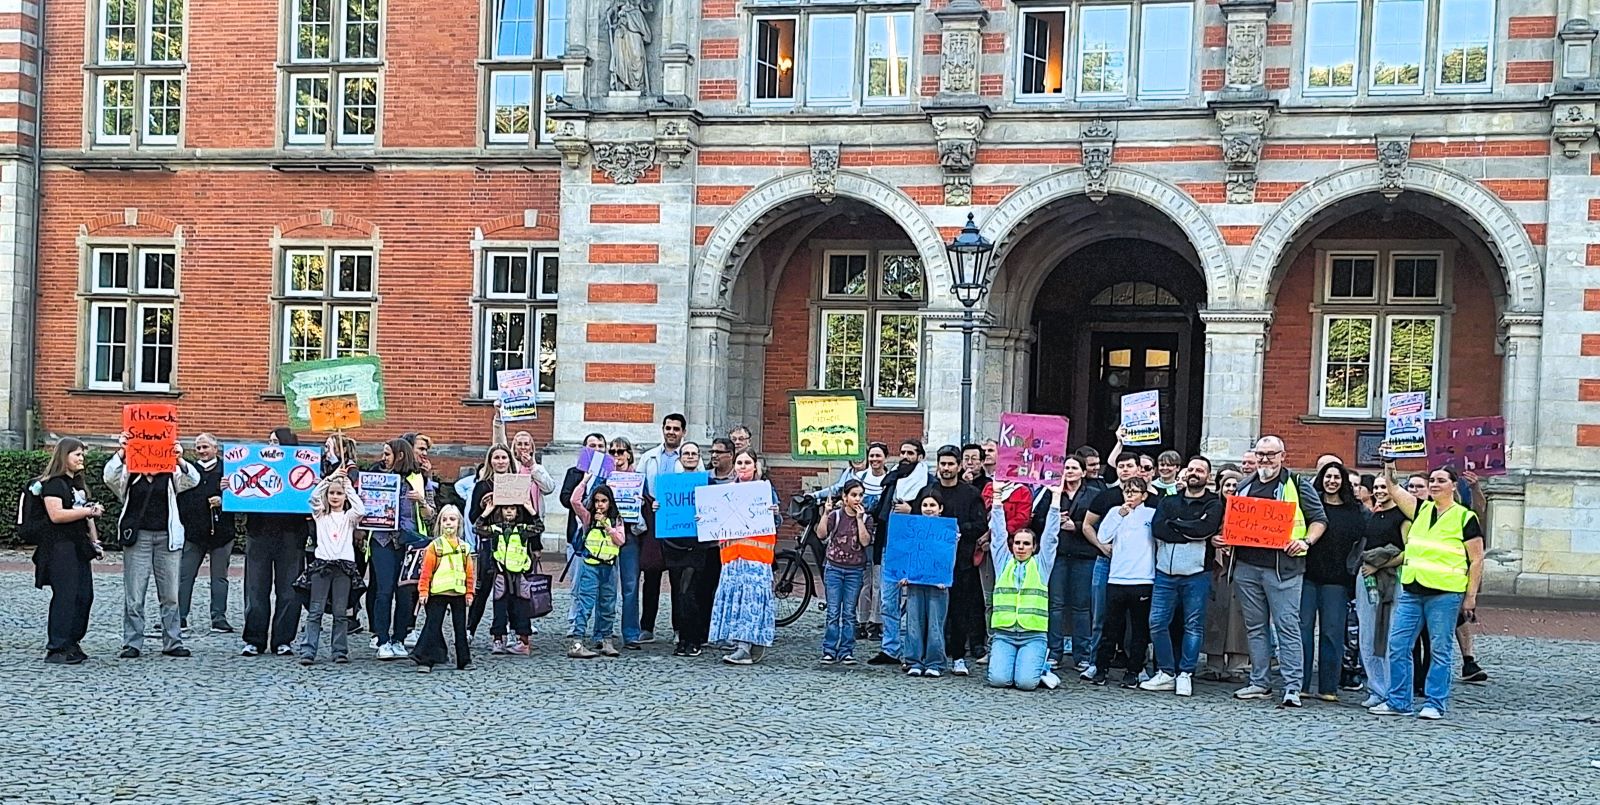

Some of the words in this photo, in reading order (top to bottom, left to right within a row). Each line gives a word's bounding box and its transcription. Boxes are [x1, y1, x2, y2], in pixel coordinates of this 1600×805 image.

[225, 447, 243, 460] Wir
[362, 475, 385, 484] DEMO
[1231, 499, 1256, 514] Kein
